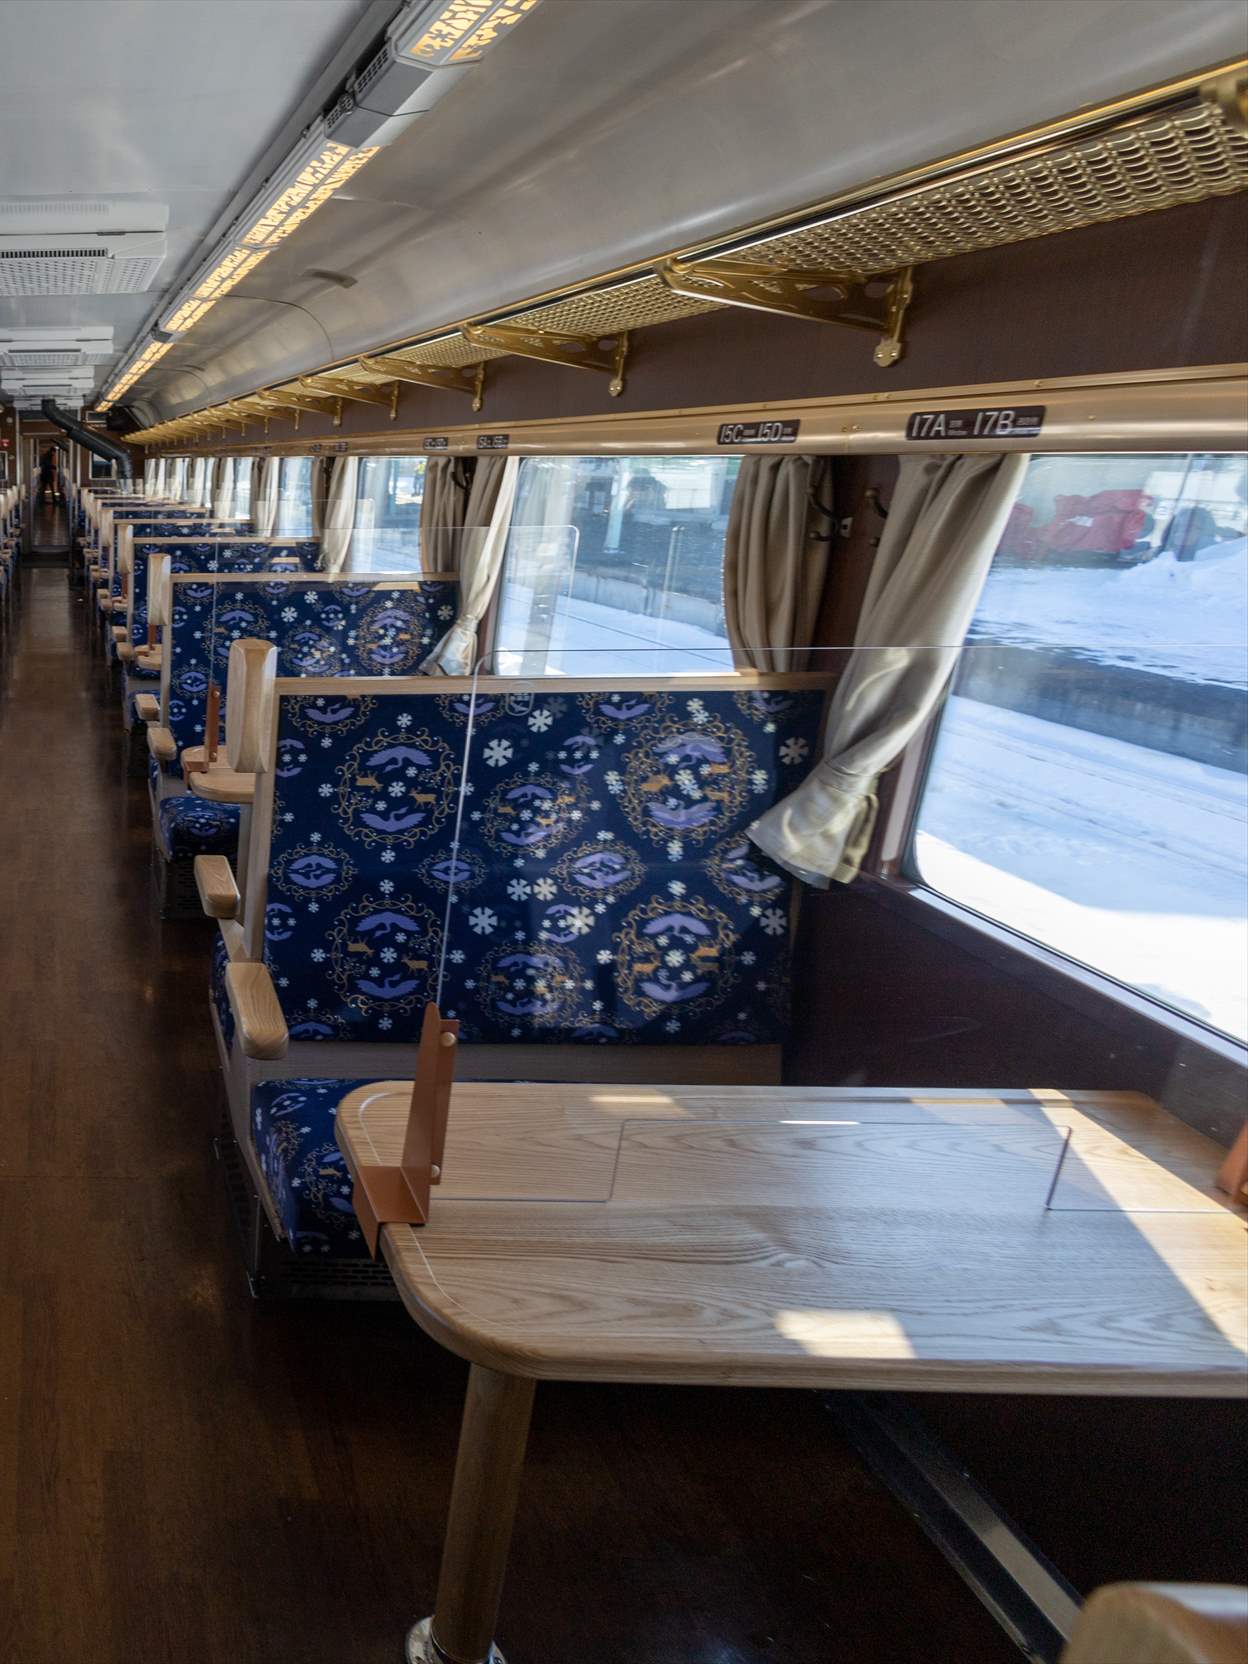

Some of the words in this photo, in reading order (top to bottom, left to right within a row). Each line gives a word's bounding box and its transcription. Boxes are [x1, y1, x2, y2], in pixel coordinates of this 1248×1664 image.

[720, 424, 744, 442] 15C
[757, 422, 783, 441] 15D
[912, 413, 946, 437] 17A
[973, 410, 1015, 435] 17B
